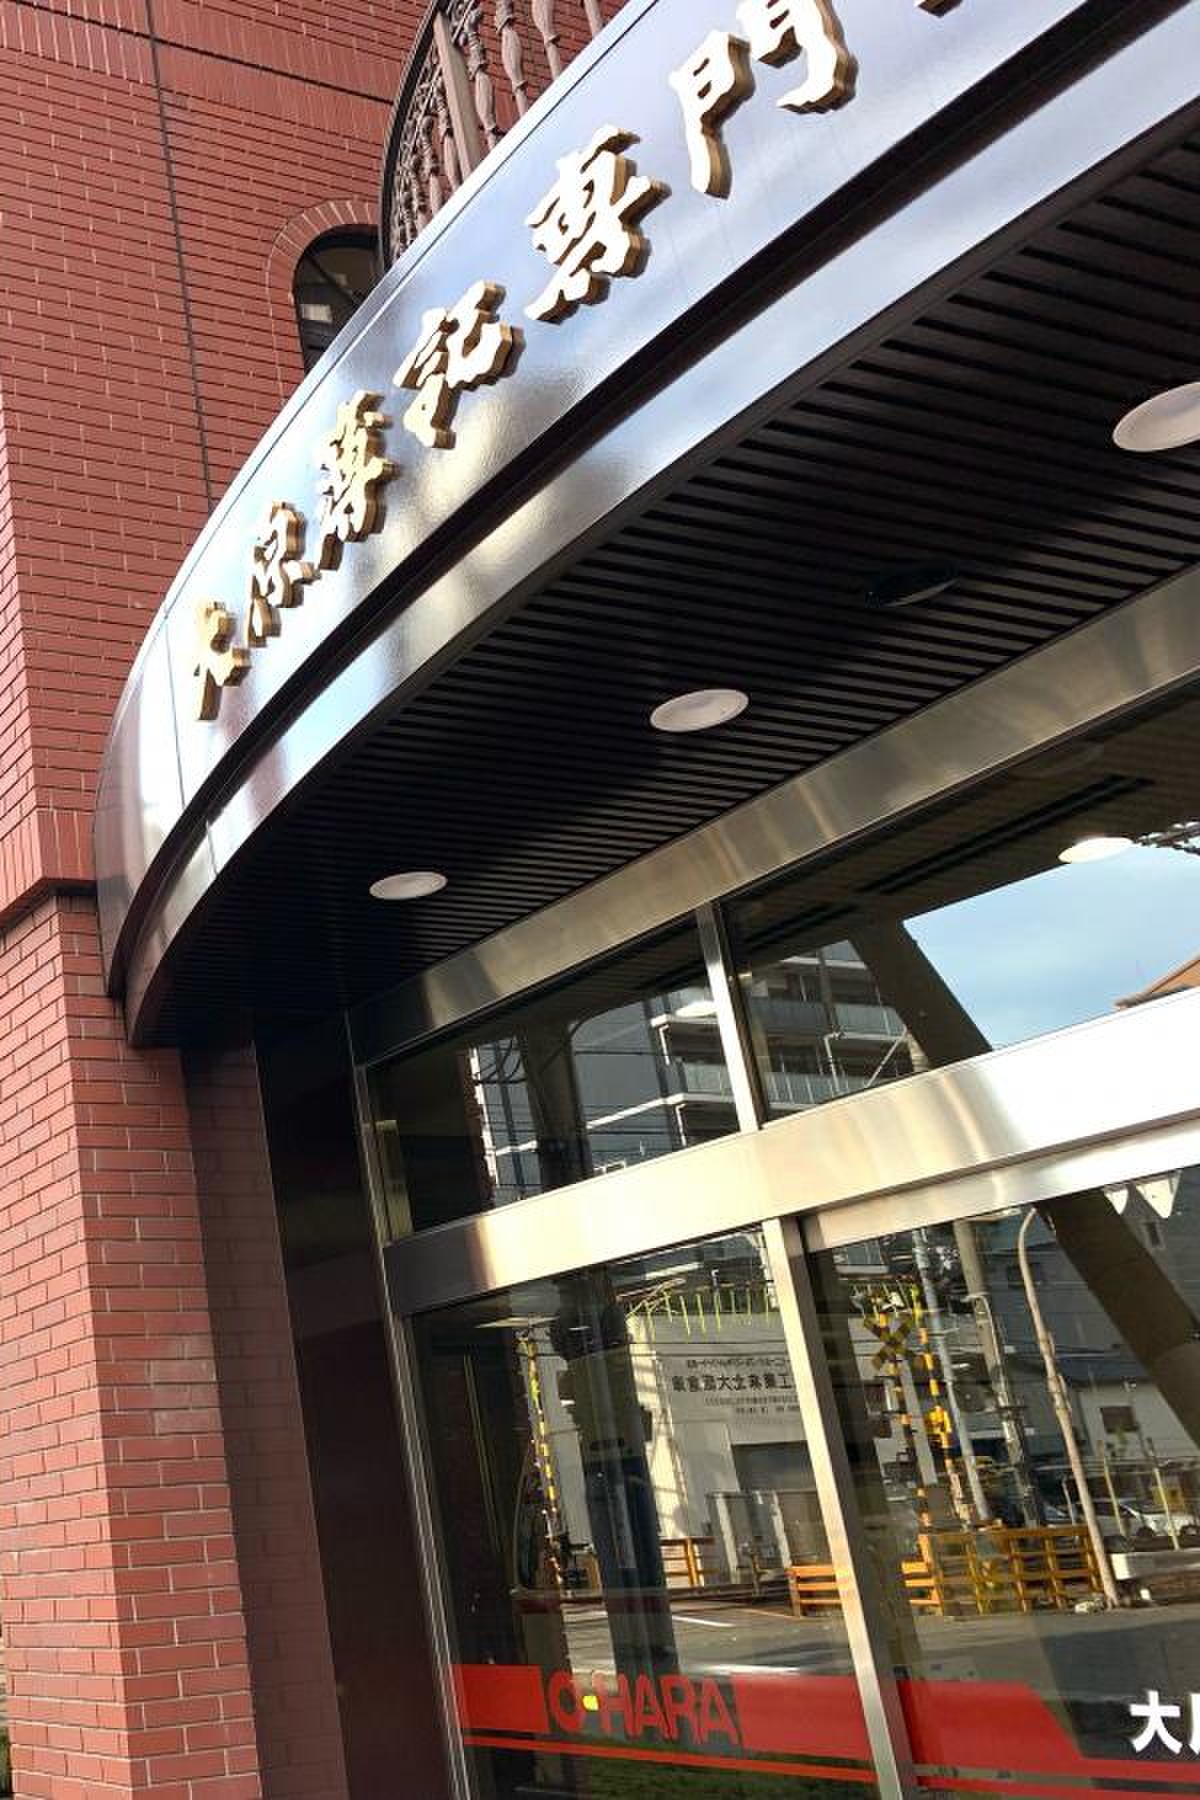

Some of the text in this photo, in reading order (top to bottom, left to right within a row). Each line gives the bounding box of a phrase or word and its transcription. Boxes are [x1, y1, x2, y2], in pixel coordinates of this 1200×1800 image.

[193, 0, 962, 721] 大原簿記専門
[1129, 1689, 1200, 1756] 大
